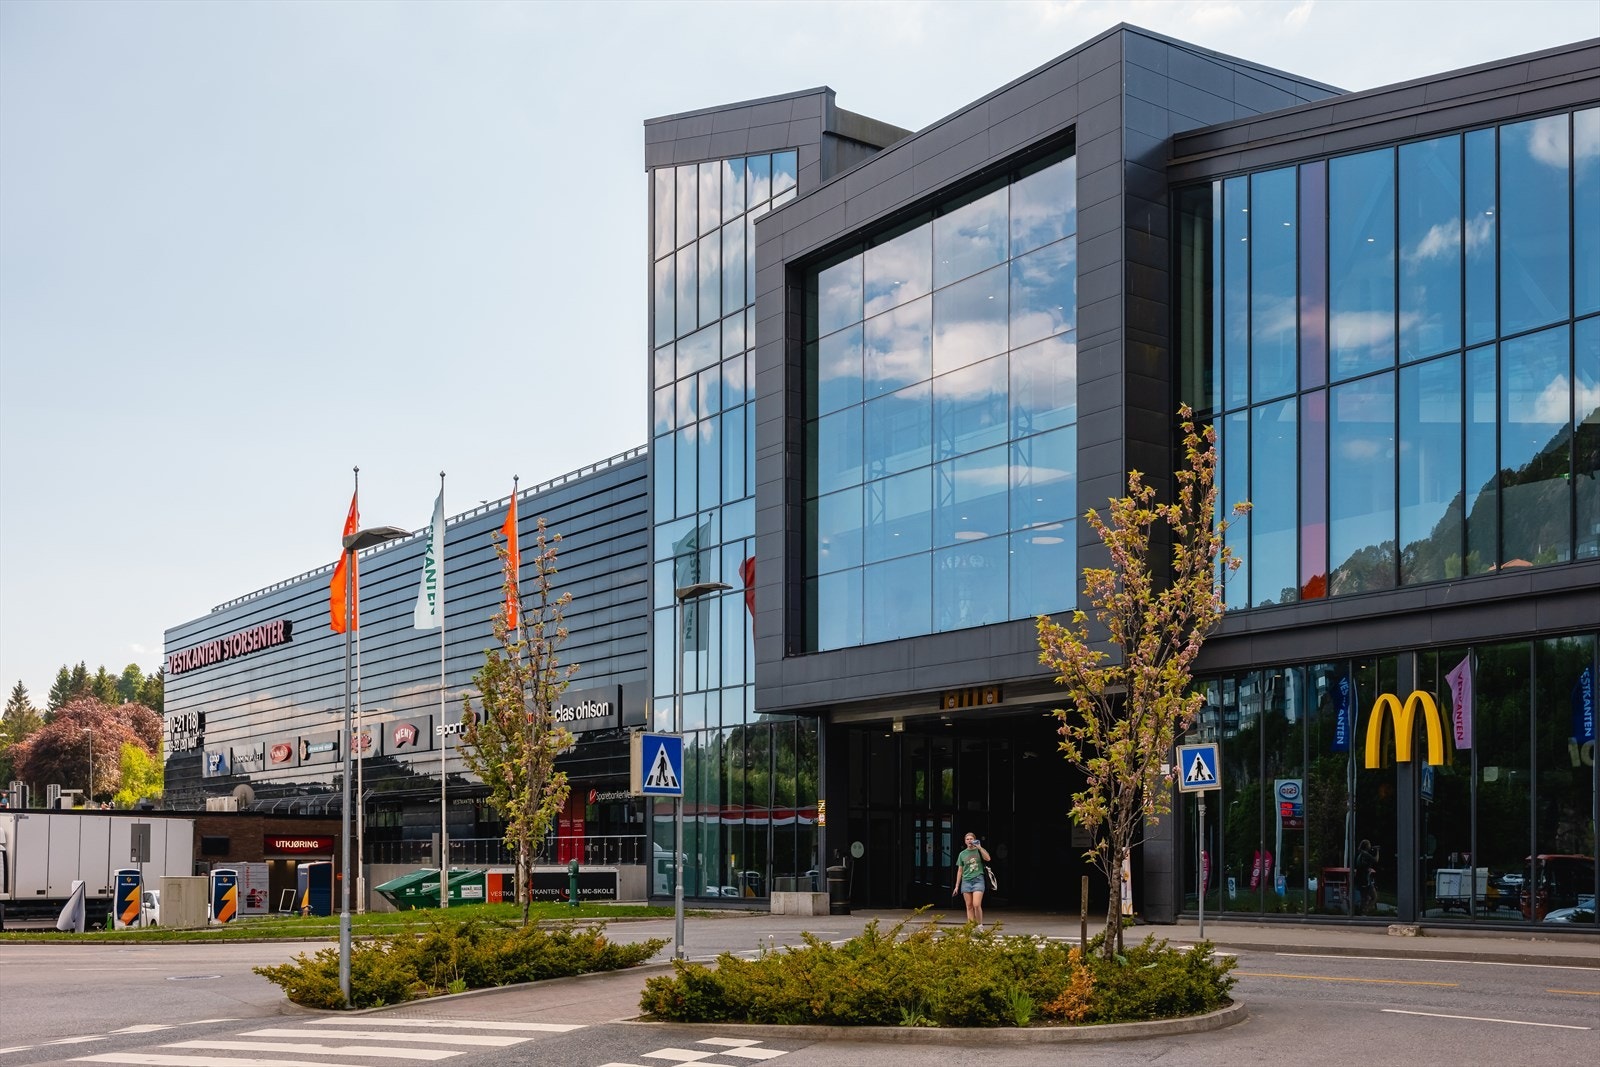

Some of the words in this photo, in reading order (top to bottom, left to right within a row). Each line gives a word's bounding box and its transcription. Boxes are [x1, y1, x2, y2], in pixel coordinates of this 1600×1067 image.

[168, 639, 222, 675] VESTKANTEN
[223, 619, 285, 660] STORSENTER
[554, 704, 575, 723] clas
[575, 700, 609, 720] ohlson
[1580, 667, 1593, 737] ESTKANTEN
[394, 727, 414, 742] MENY
[275, 840, 319, 848] UTKJØRING
